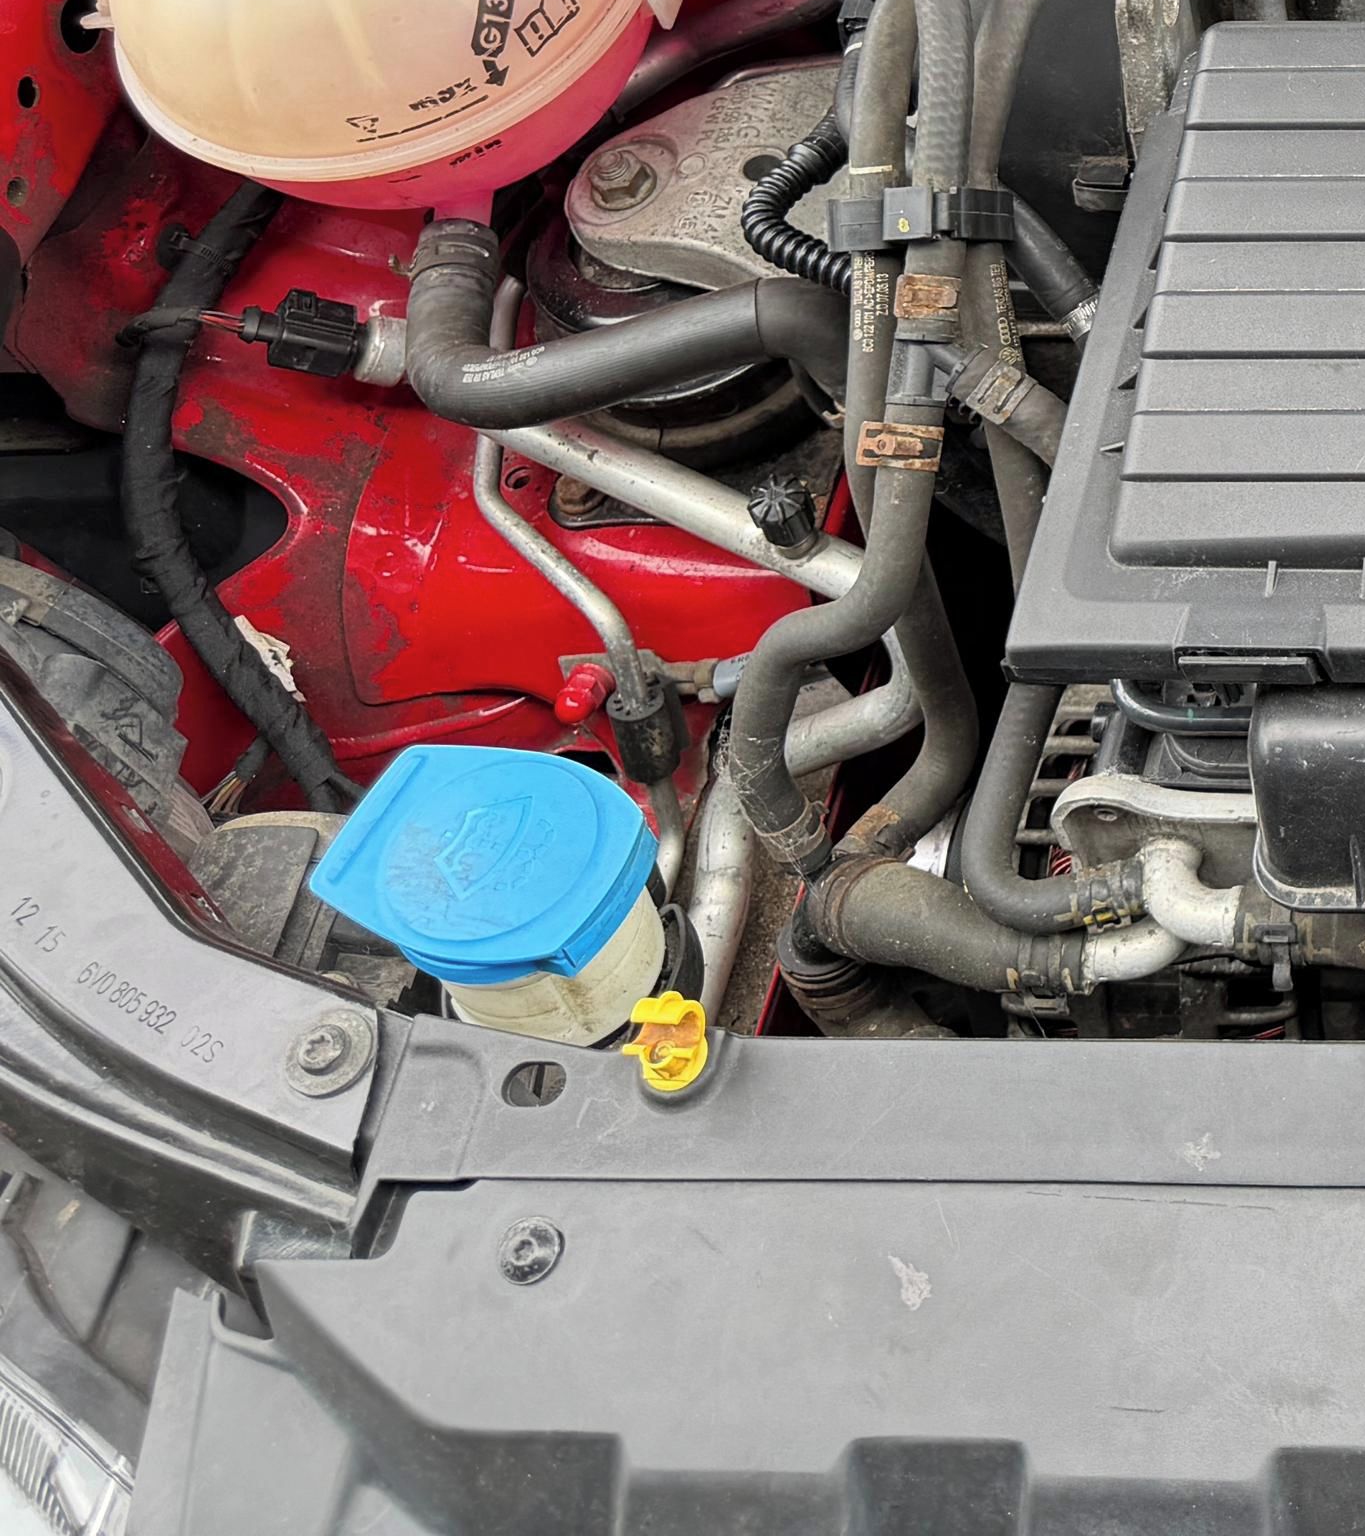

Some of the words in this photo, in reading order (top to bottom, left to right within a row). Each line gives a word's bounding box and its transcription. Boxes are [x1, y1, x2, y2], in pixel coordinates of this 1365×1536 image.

[9, 896, 40, 931] 12
[36, 923, 67, 956] 15
[108, 976, 144, 1017] 805
[138, 995, 179, 1036] 932
